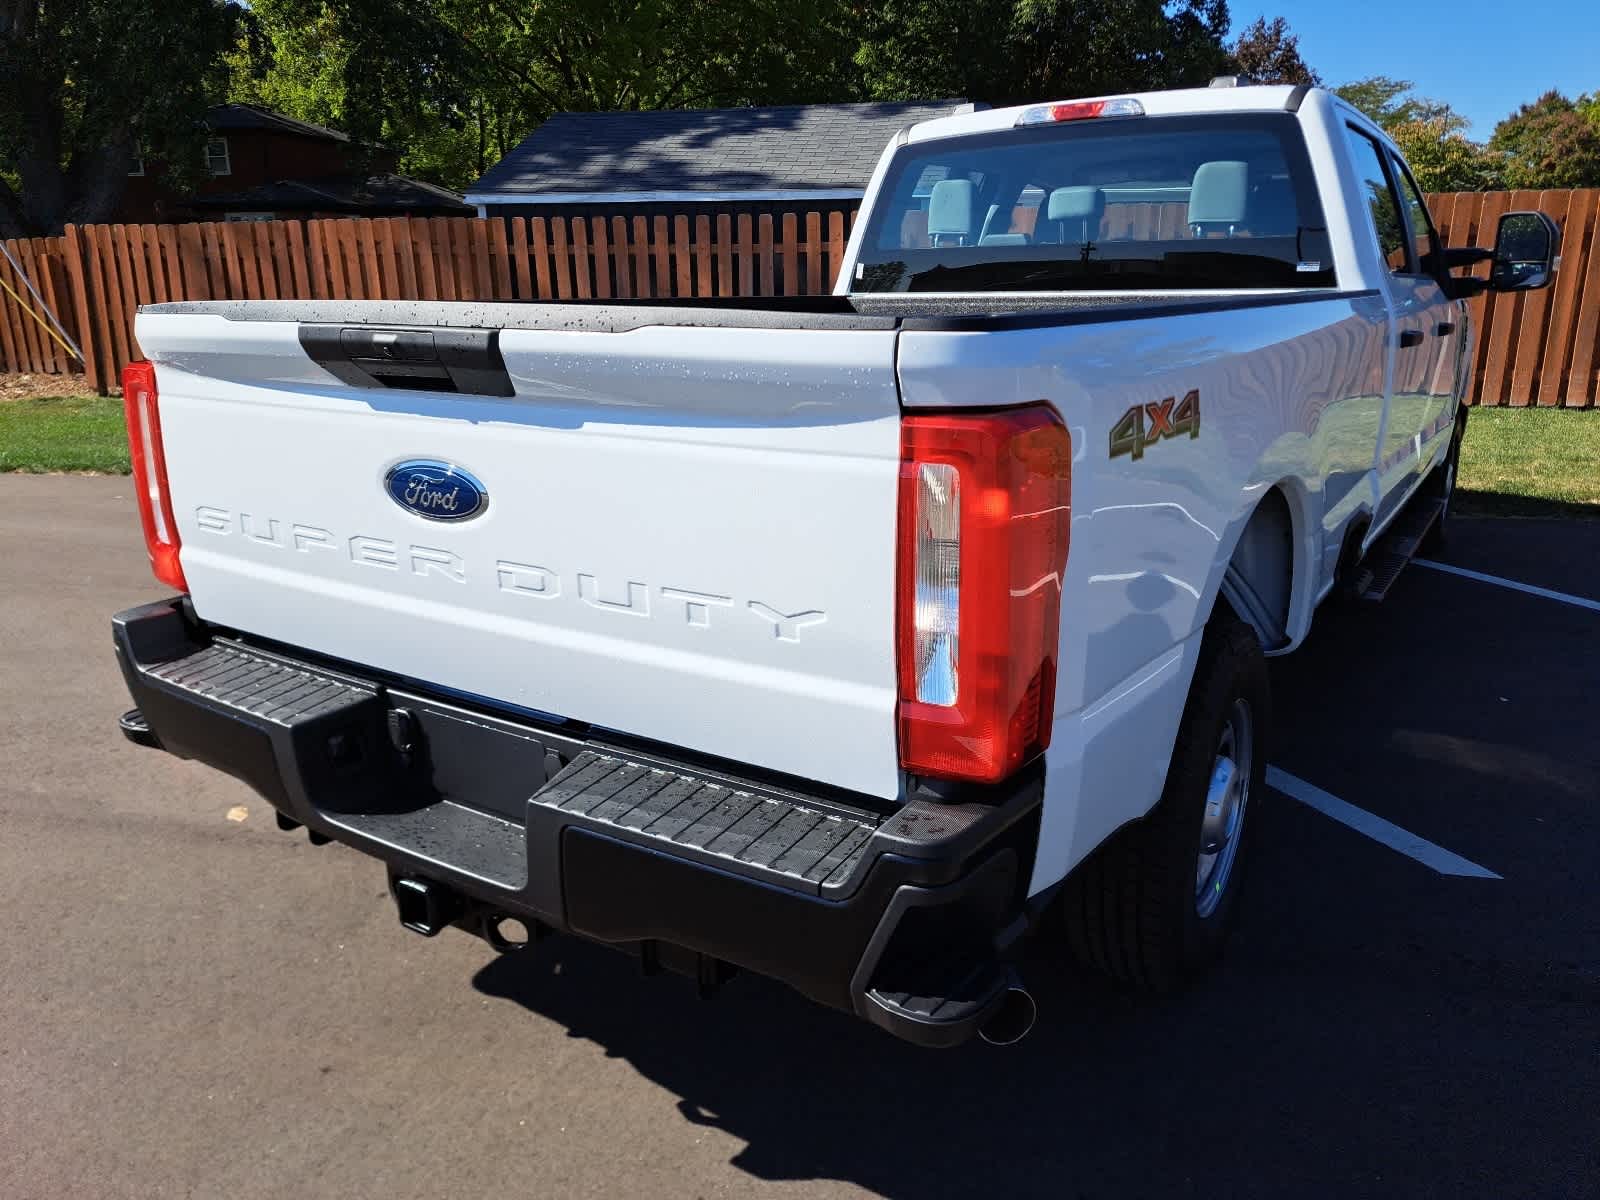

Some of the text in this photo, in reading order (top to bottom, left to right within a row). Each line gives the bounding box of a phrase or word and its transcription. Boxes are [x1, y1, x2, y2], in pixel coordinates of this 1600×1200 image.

[404, 473, 459, 511] Ford
[195, 505, 826, 643] SUPER DUTY
